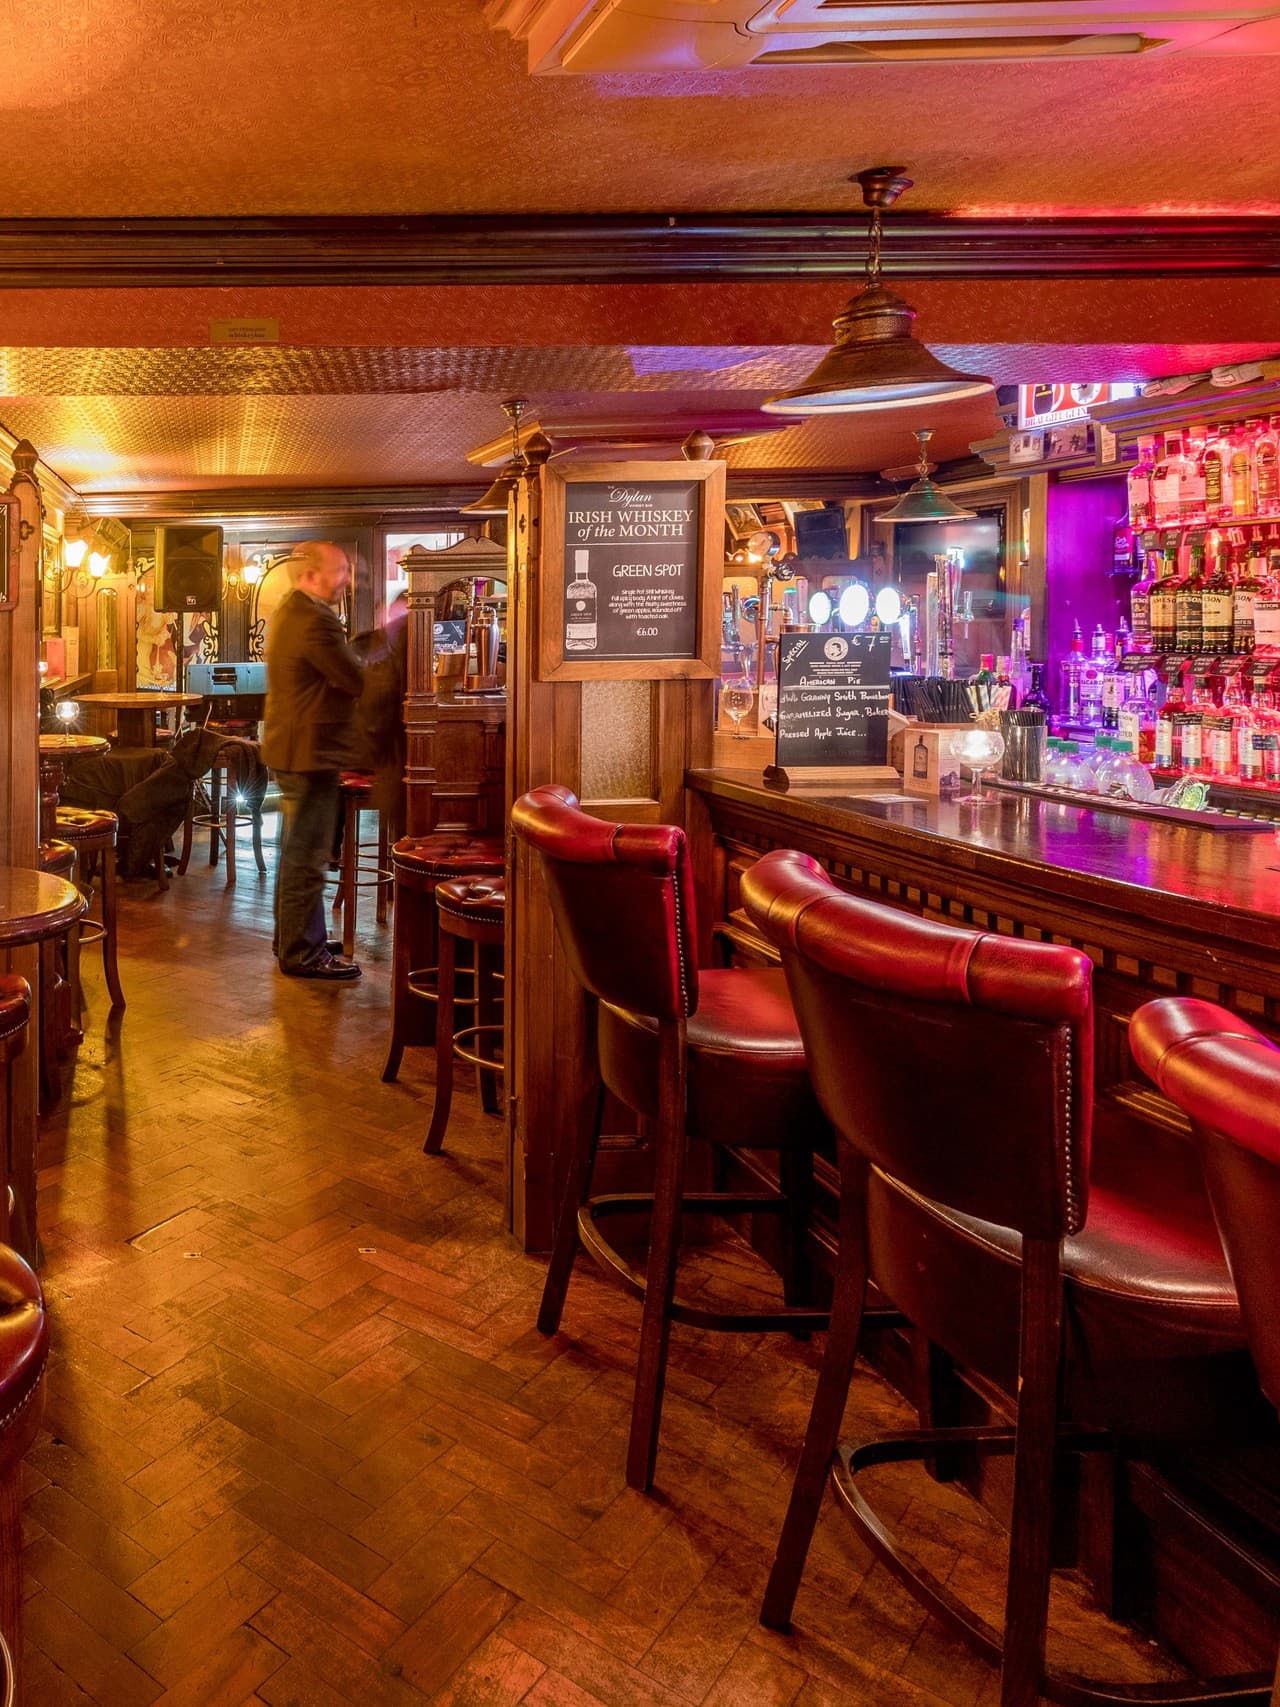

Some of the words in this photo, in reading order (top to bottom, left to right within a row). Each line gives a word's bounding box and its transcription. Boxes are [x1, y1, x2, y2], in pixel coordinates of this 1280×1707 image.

[607, 487, 653, 509] Dylan
[568, 510, 613, 525] IRISH
[617, 509, 694, 524] WHISKEY
[577, 525, 593, 541] of
[594, 525, 616, 538] the
[618, 523, 685, 538] MONTH
[612, 564, 652, 578] GREEN
[654, 563, 685, 577] SPOT
[636, 627, 659, 637] €6.00
